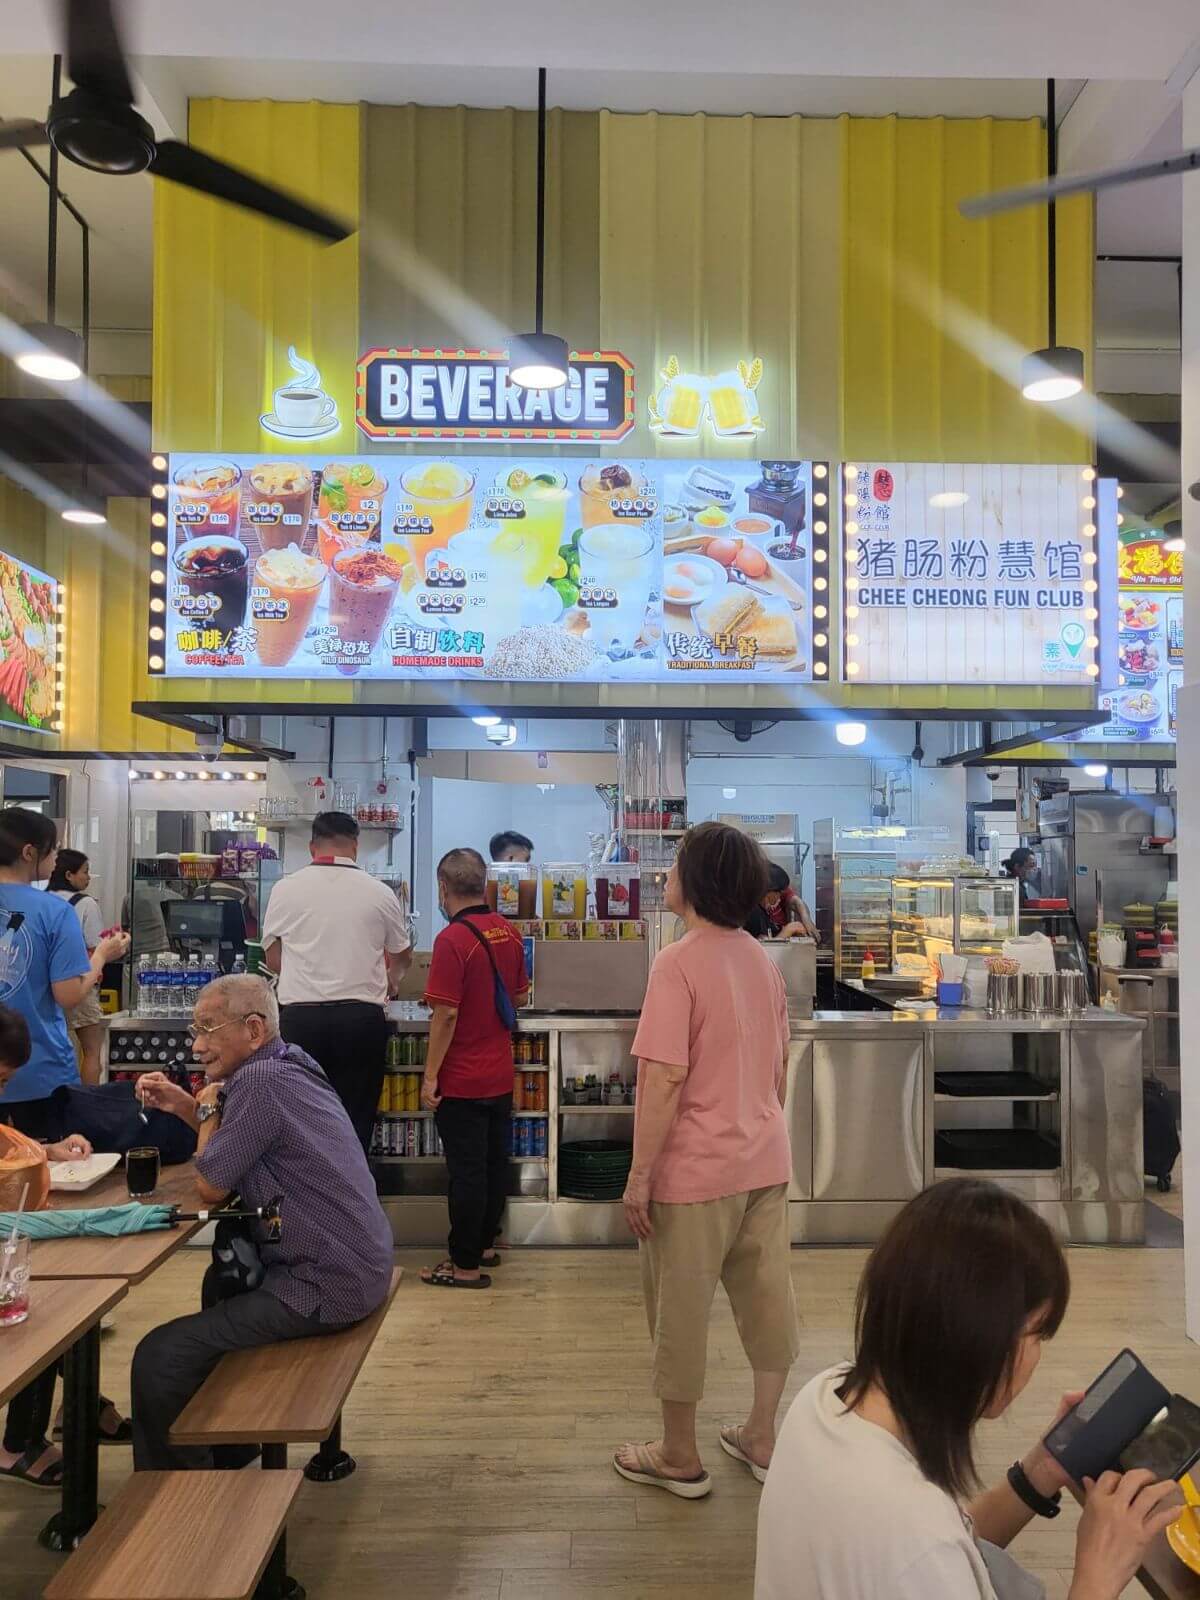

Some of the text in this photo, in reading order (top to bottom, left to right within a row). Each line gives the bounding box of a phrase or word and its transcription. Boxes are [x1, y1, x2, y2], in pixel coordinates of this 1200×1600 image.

[380, 364, 610, 422] BEVERAGE
[857, 538, 1083, 579] 猪肠粉慧馆
[858, 588, 1084, 607] CHEE CHEONG FUN CLUB
[177, 625, 259, 652] 咖啡/茶
[390, 624, 485, 653] 自制饮料
[667, 632, 759, 659] 传统早餐
[392, 656, 484, 667] HOMEMADE DRINKS
[667, 661, 756, 669] TRADITIONAL BREAKFAST
